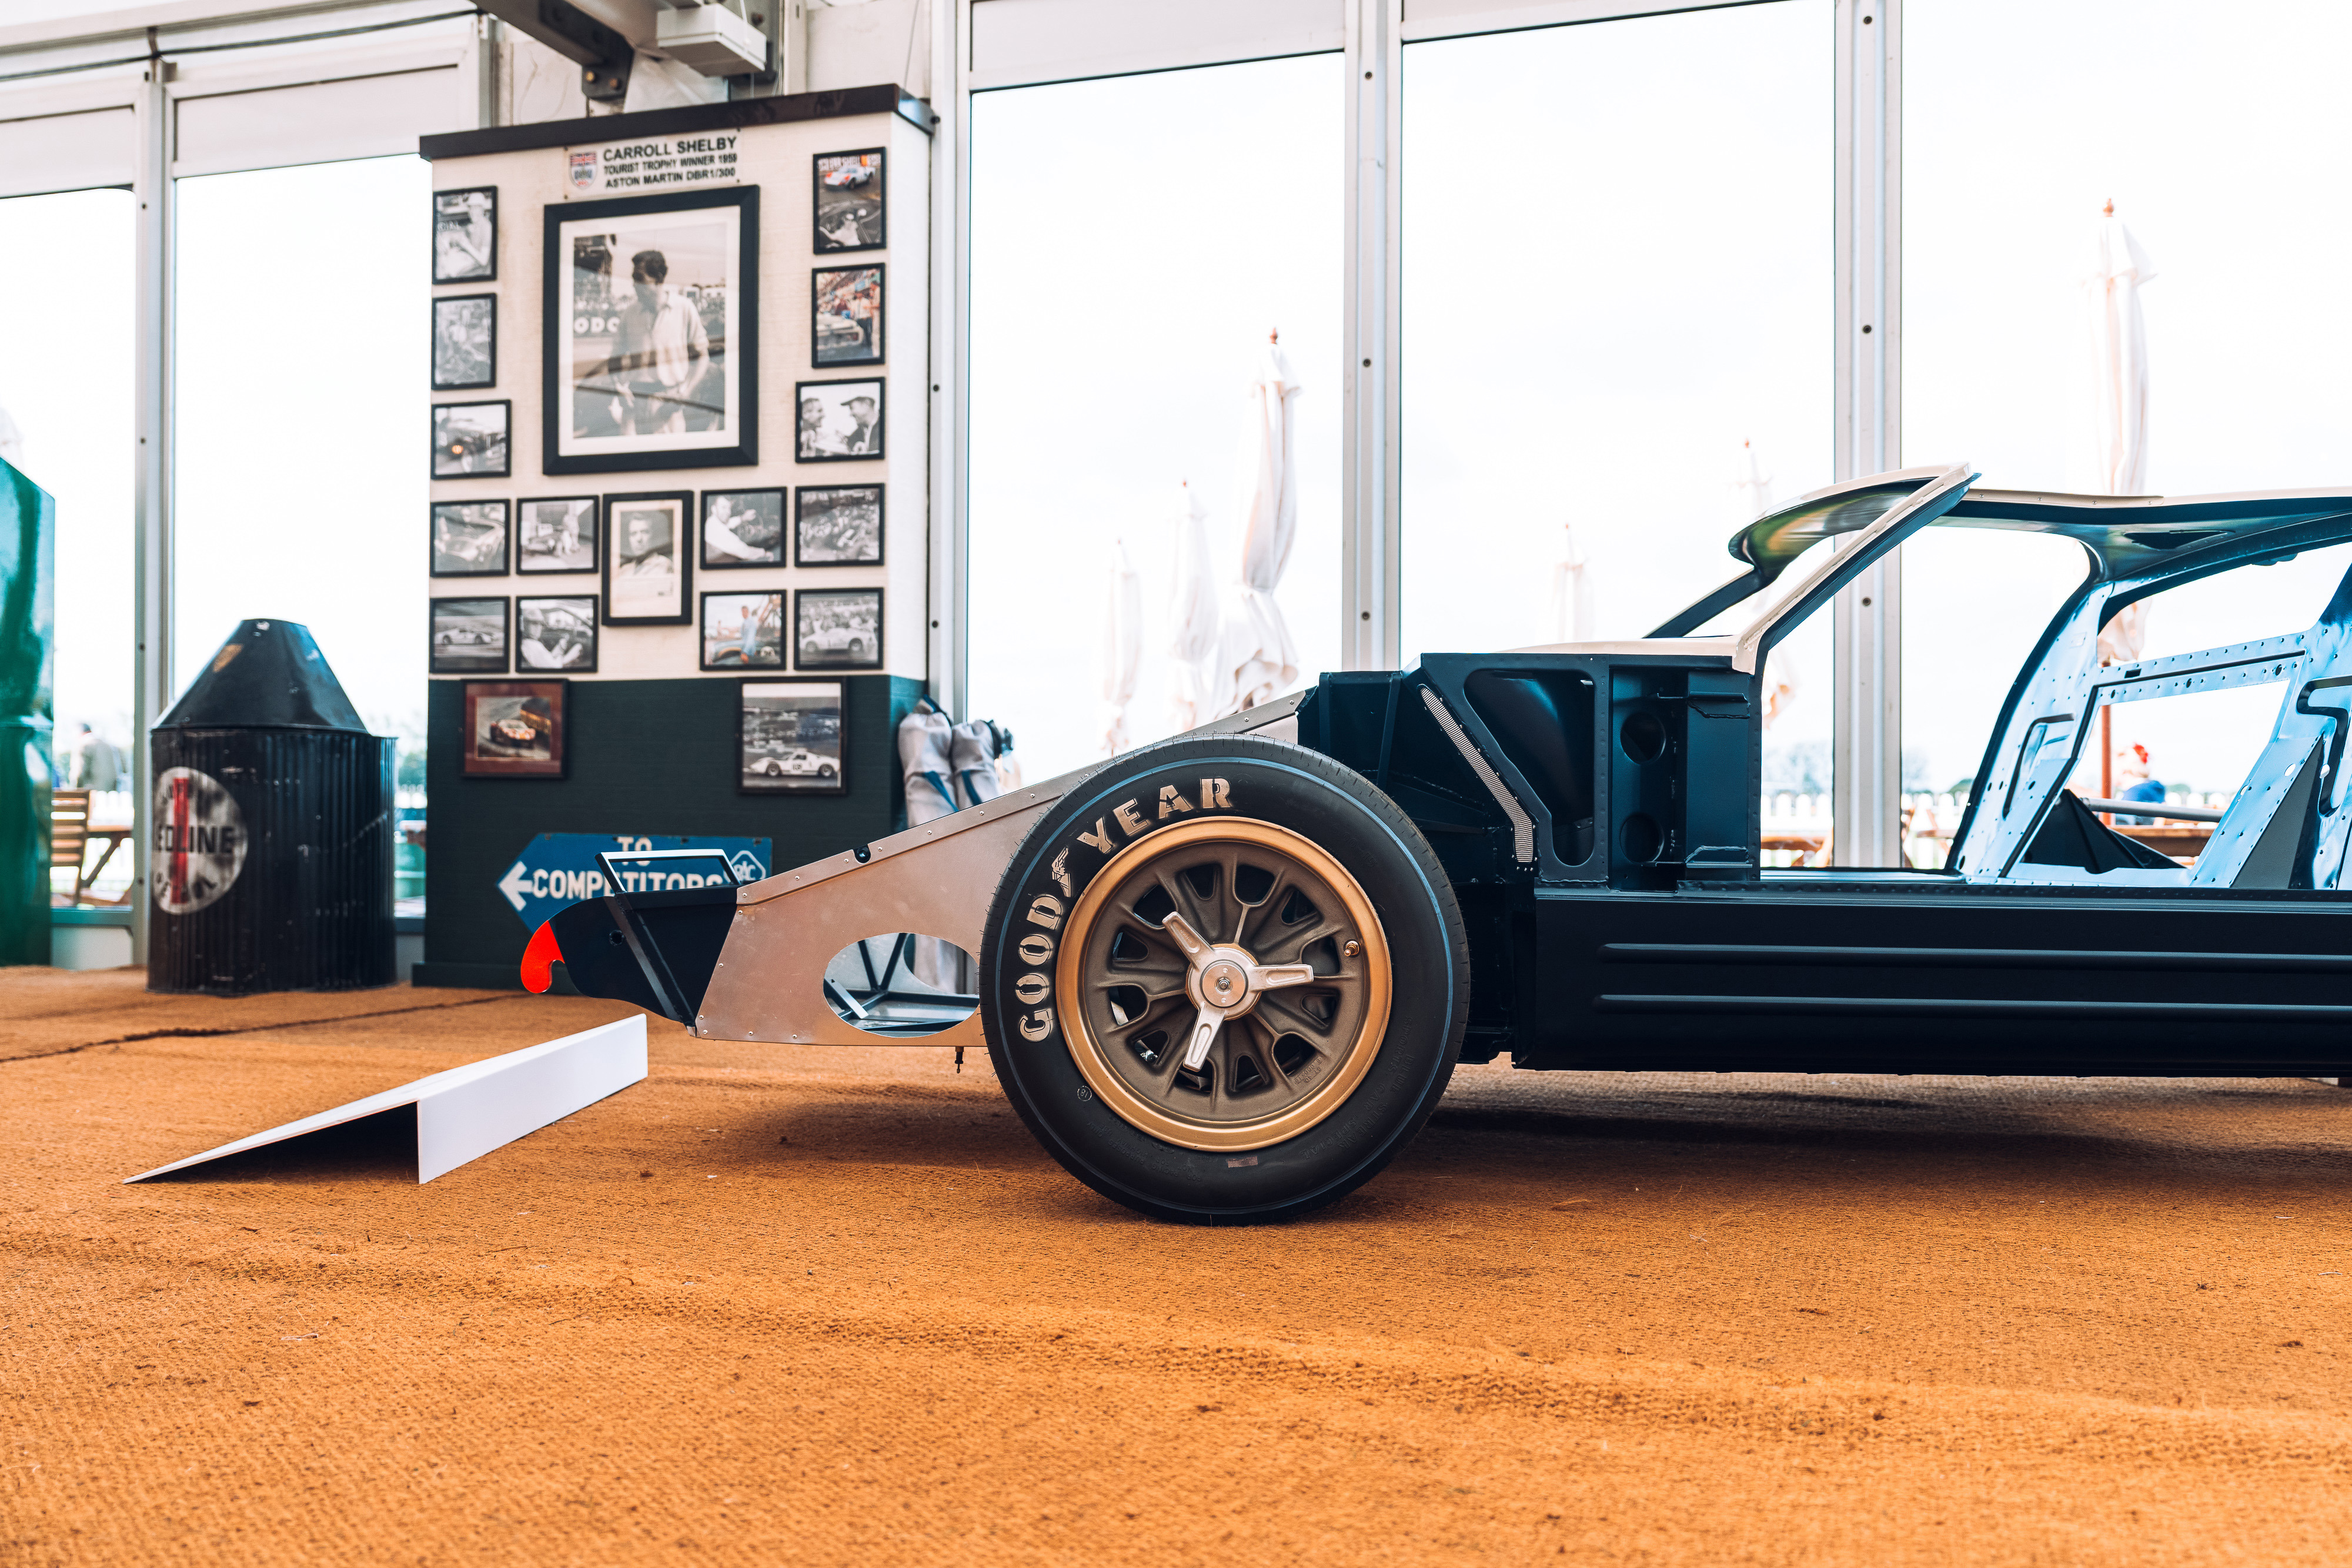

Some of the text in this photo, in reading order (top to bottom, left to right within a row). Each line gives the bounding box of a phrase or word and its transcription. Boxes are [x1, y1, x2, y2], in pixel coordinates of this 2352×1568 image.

[603, 136, 736, 162] CARROLL SHELBY
[603, 162, 639, 175] TOURIST
[643, 158, 677, 171] TROPHY
[680, 155, 715, 167] WINNER
[606, 176, 640, 189] ASTON
[644, 172, 683, 186] MARTIN
[617, 836, 653, 867] TO
